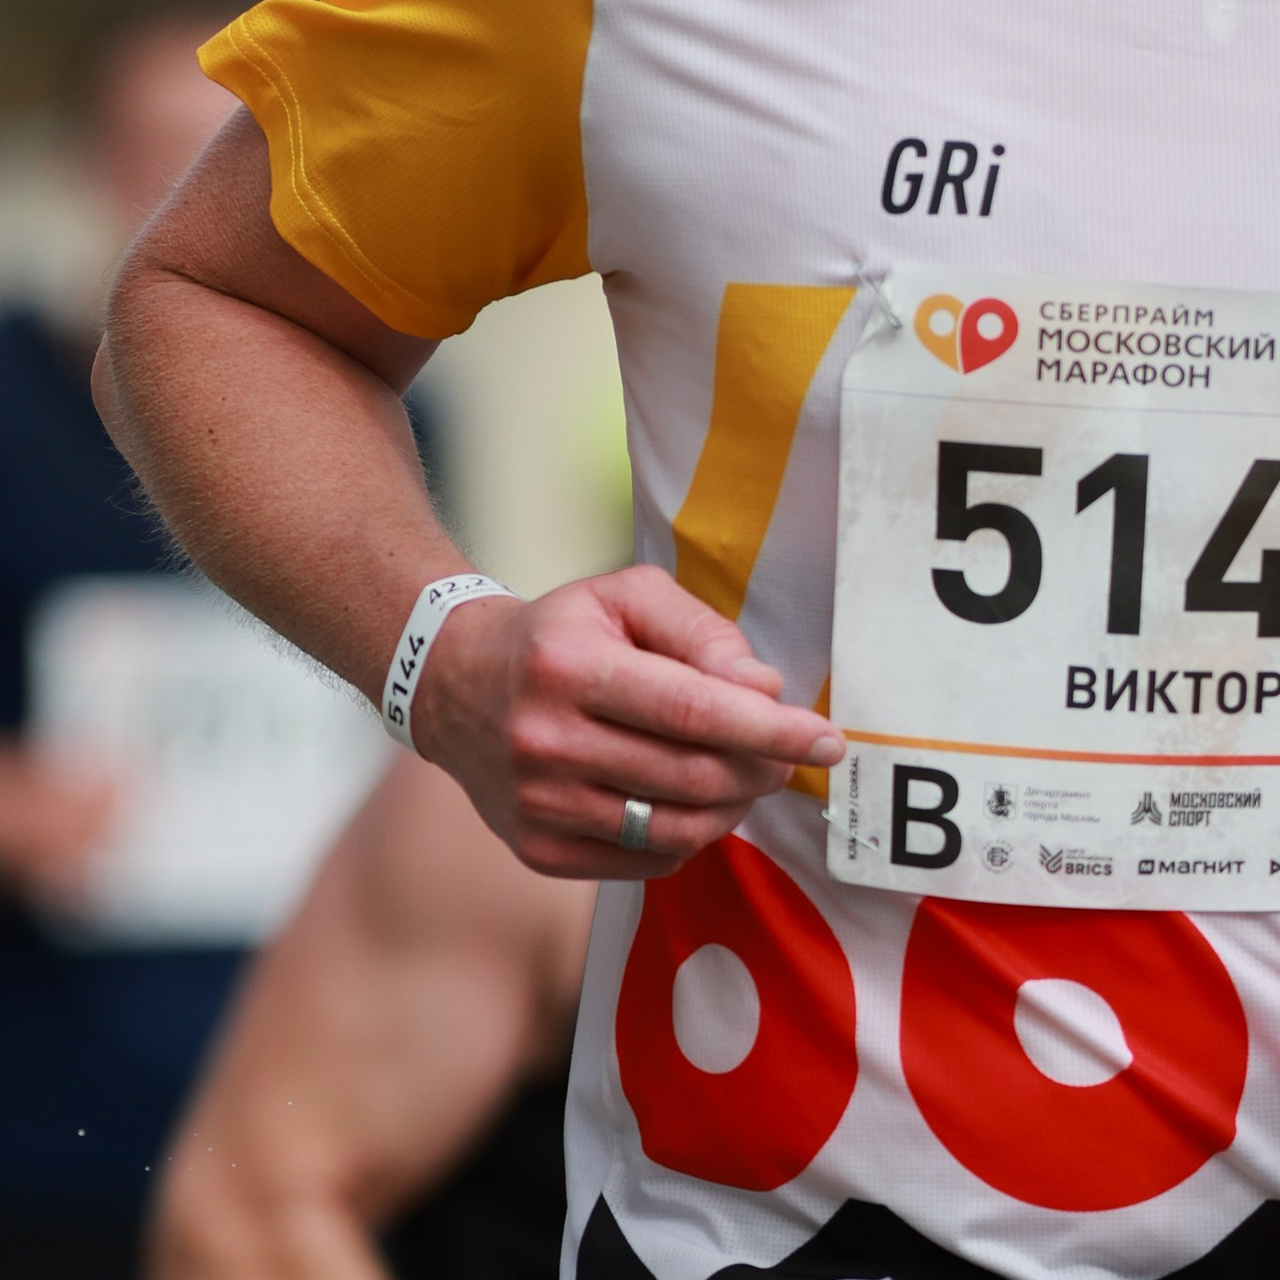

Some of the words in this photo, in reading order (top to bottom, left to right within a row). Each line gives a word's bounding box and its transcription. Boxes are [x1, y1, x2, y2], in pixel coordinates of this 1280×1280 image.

[881, 138, 1006, 217] GRi
[1039, 300, 1215, 328] СБЕРПРАЙМ
[1037, 327, 1277, 362] МОСКОВСКИЙ
[1036, 359, 1211, 389] МАРАФОН
[388, 633, 425, 727] 5144
[1169, 787, 1262, 809] МОСКОВСКИЙ
[1168, 810, 1211, 827] СПОРТ
[1065, 862, 1113, 876] BRICS
[1158, 859, 1246, 875] магнит
